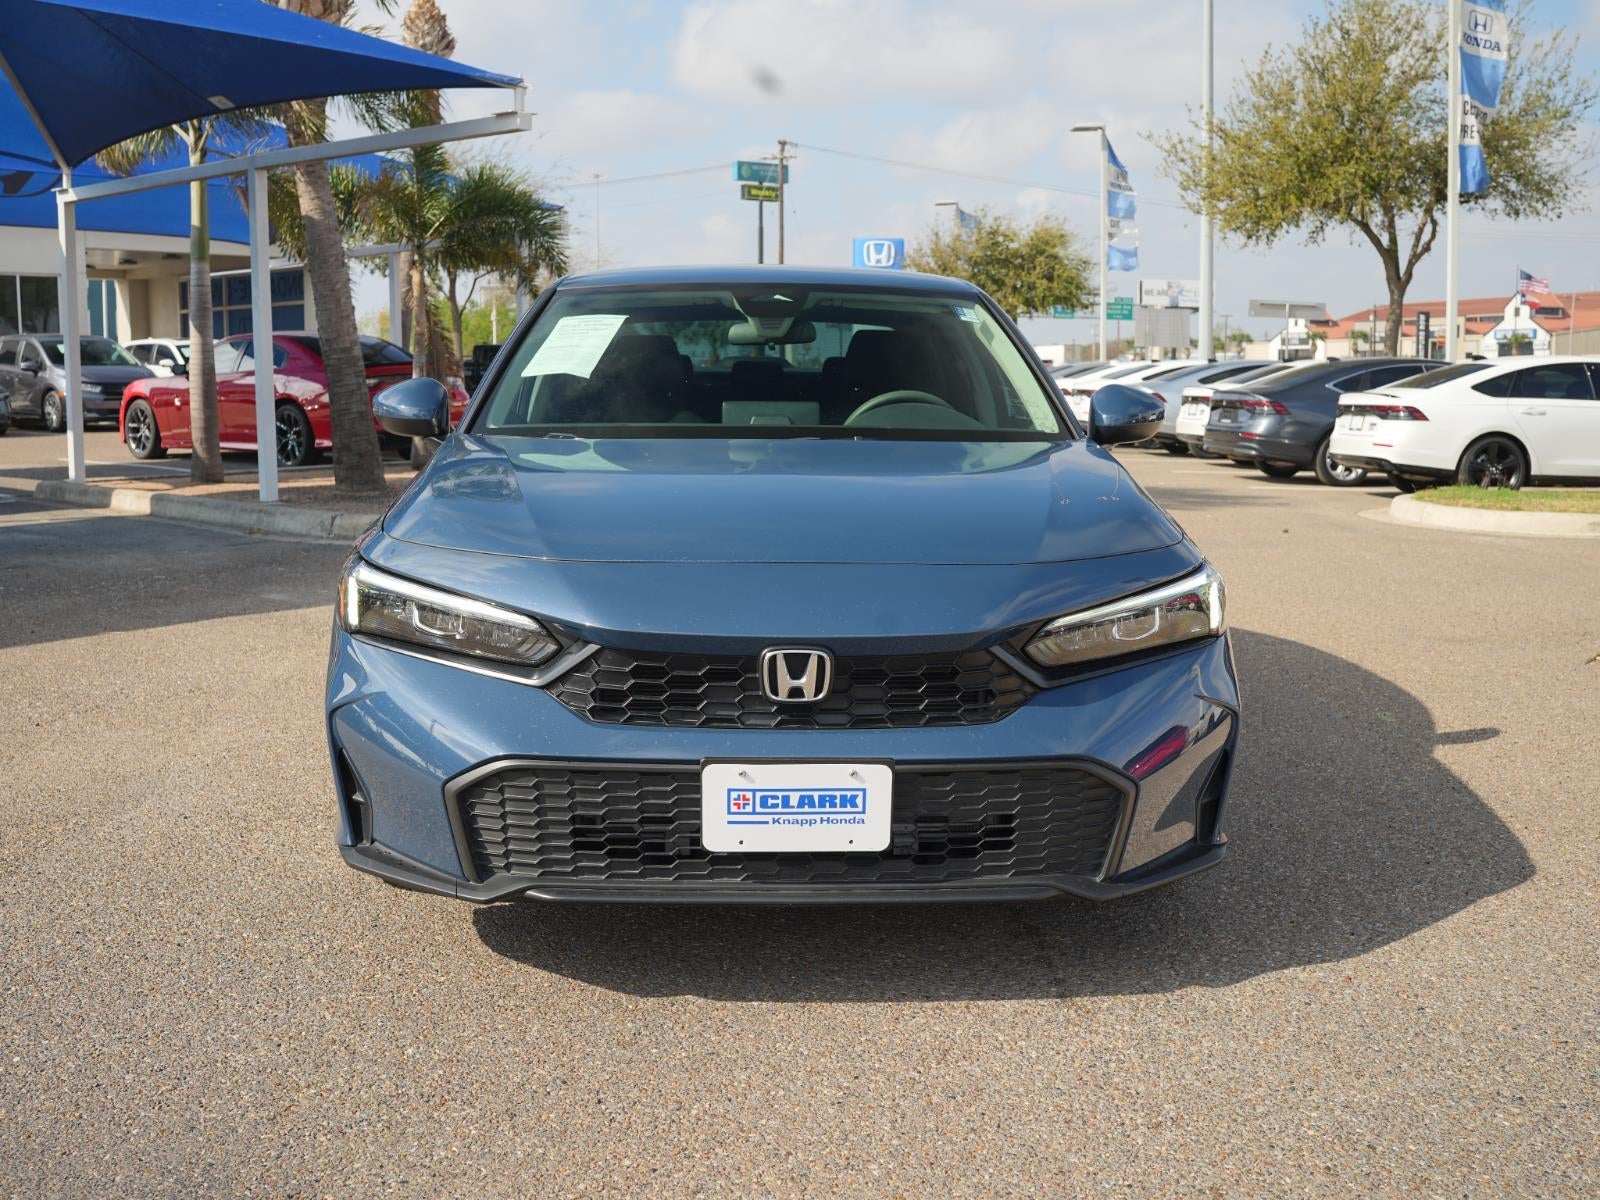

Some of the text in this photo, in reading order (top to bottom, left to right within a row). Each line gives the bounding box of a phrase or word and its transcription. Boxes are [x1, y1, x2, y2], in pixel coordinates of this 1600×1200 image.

[759, 794, 859, 809] CLARK
[772, 816, 866, 826] Knapp Honda
